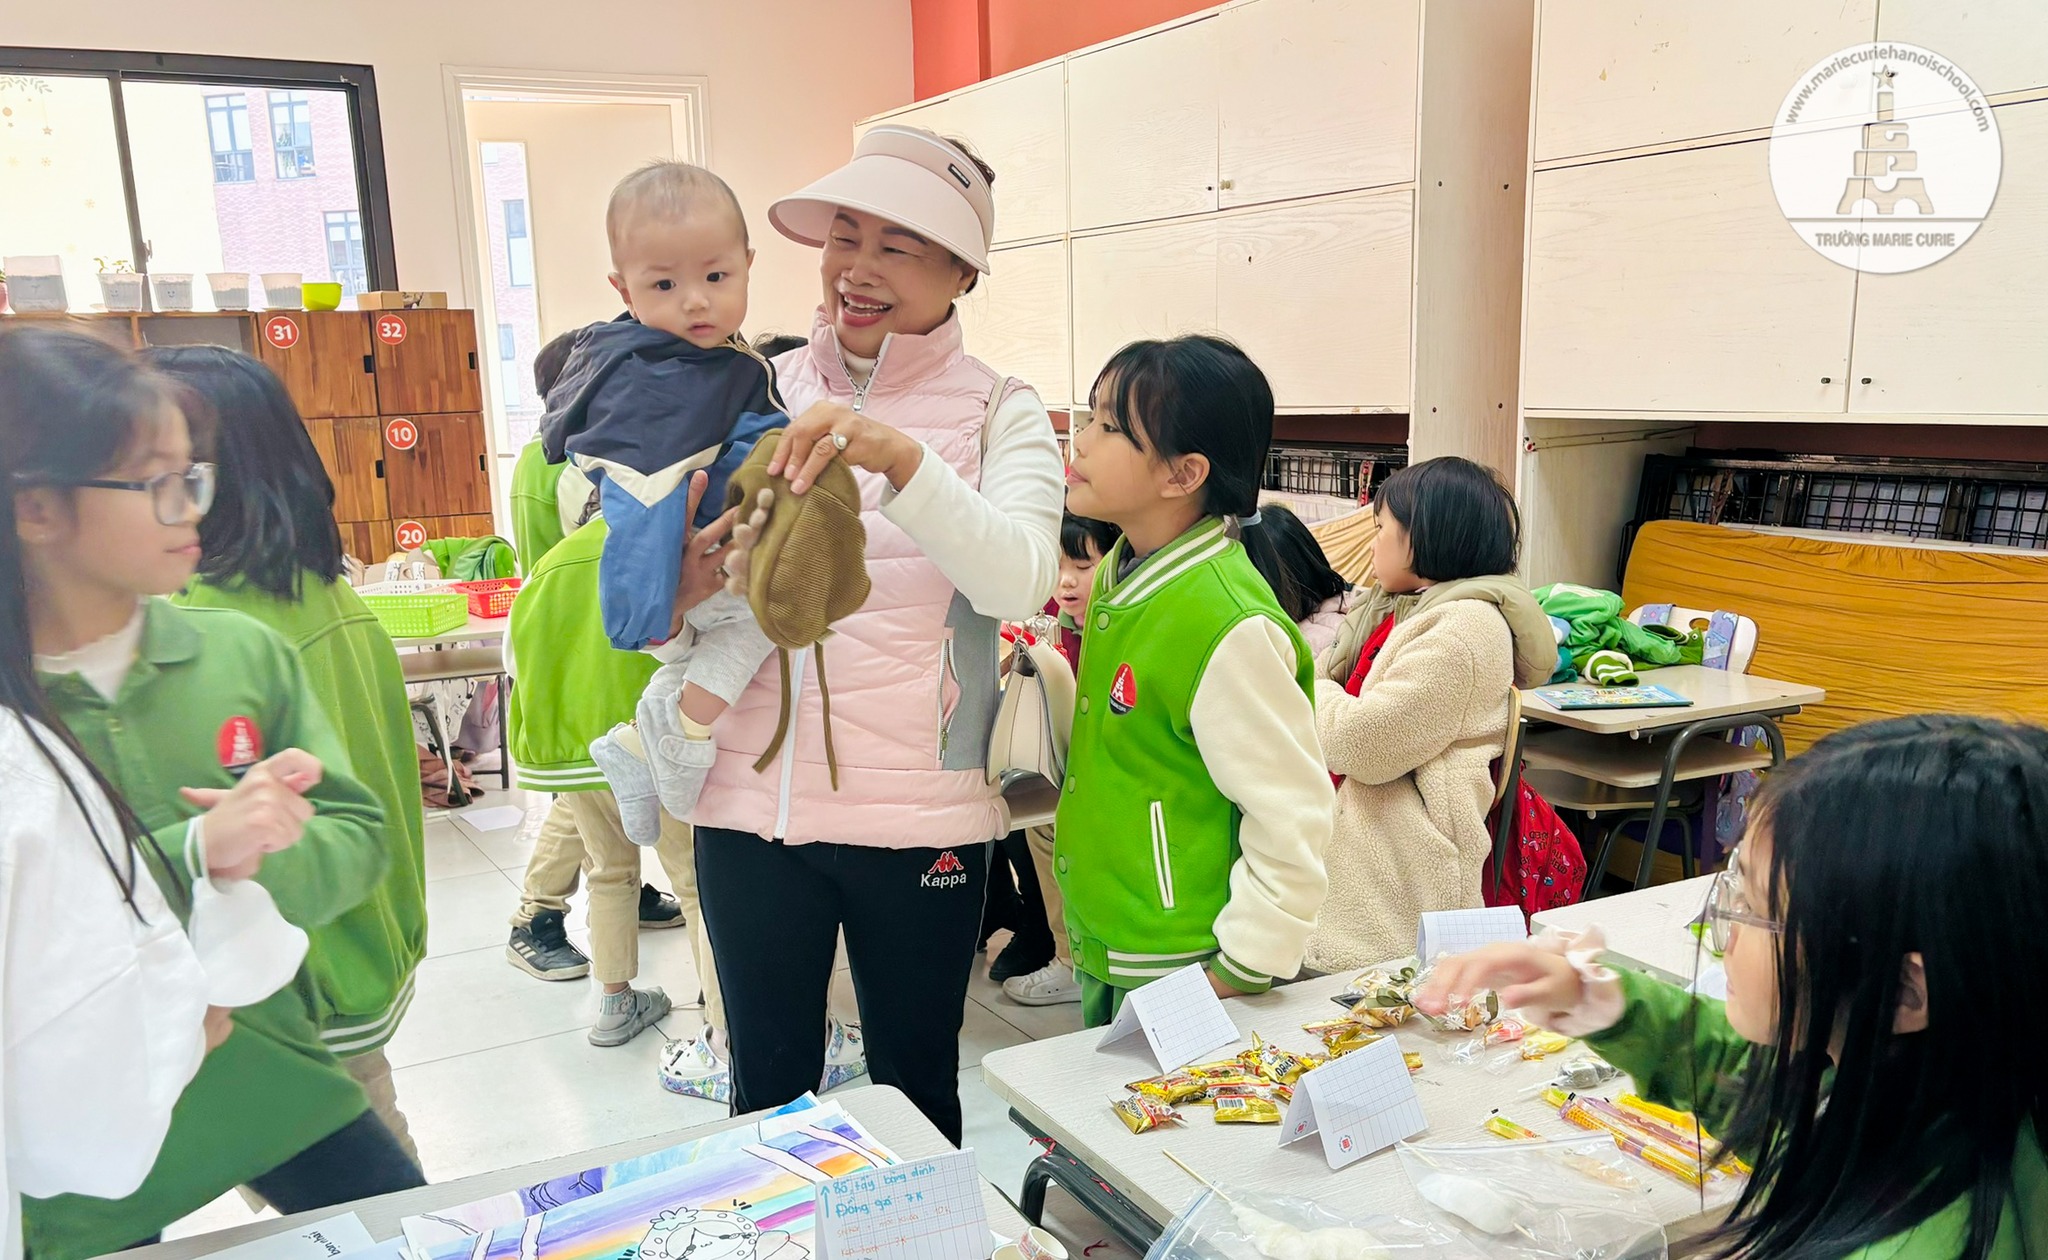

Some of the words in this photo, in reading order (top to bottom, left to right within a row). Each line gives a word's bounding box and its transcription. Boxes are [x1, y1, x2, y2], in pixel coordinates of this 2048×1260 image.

[273, 325, 292, 341] 31
[381, 323, 402, 339] 32
[391, 427, 412, 442] 10
[400, 529, 422, 544] 20
[920, 873, 967, 889] Kappa
